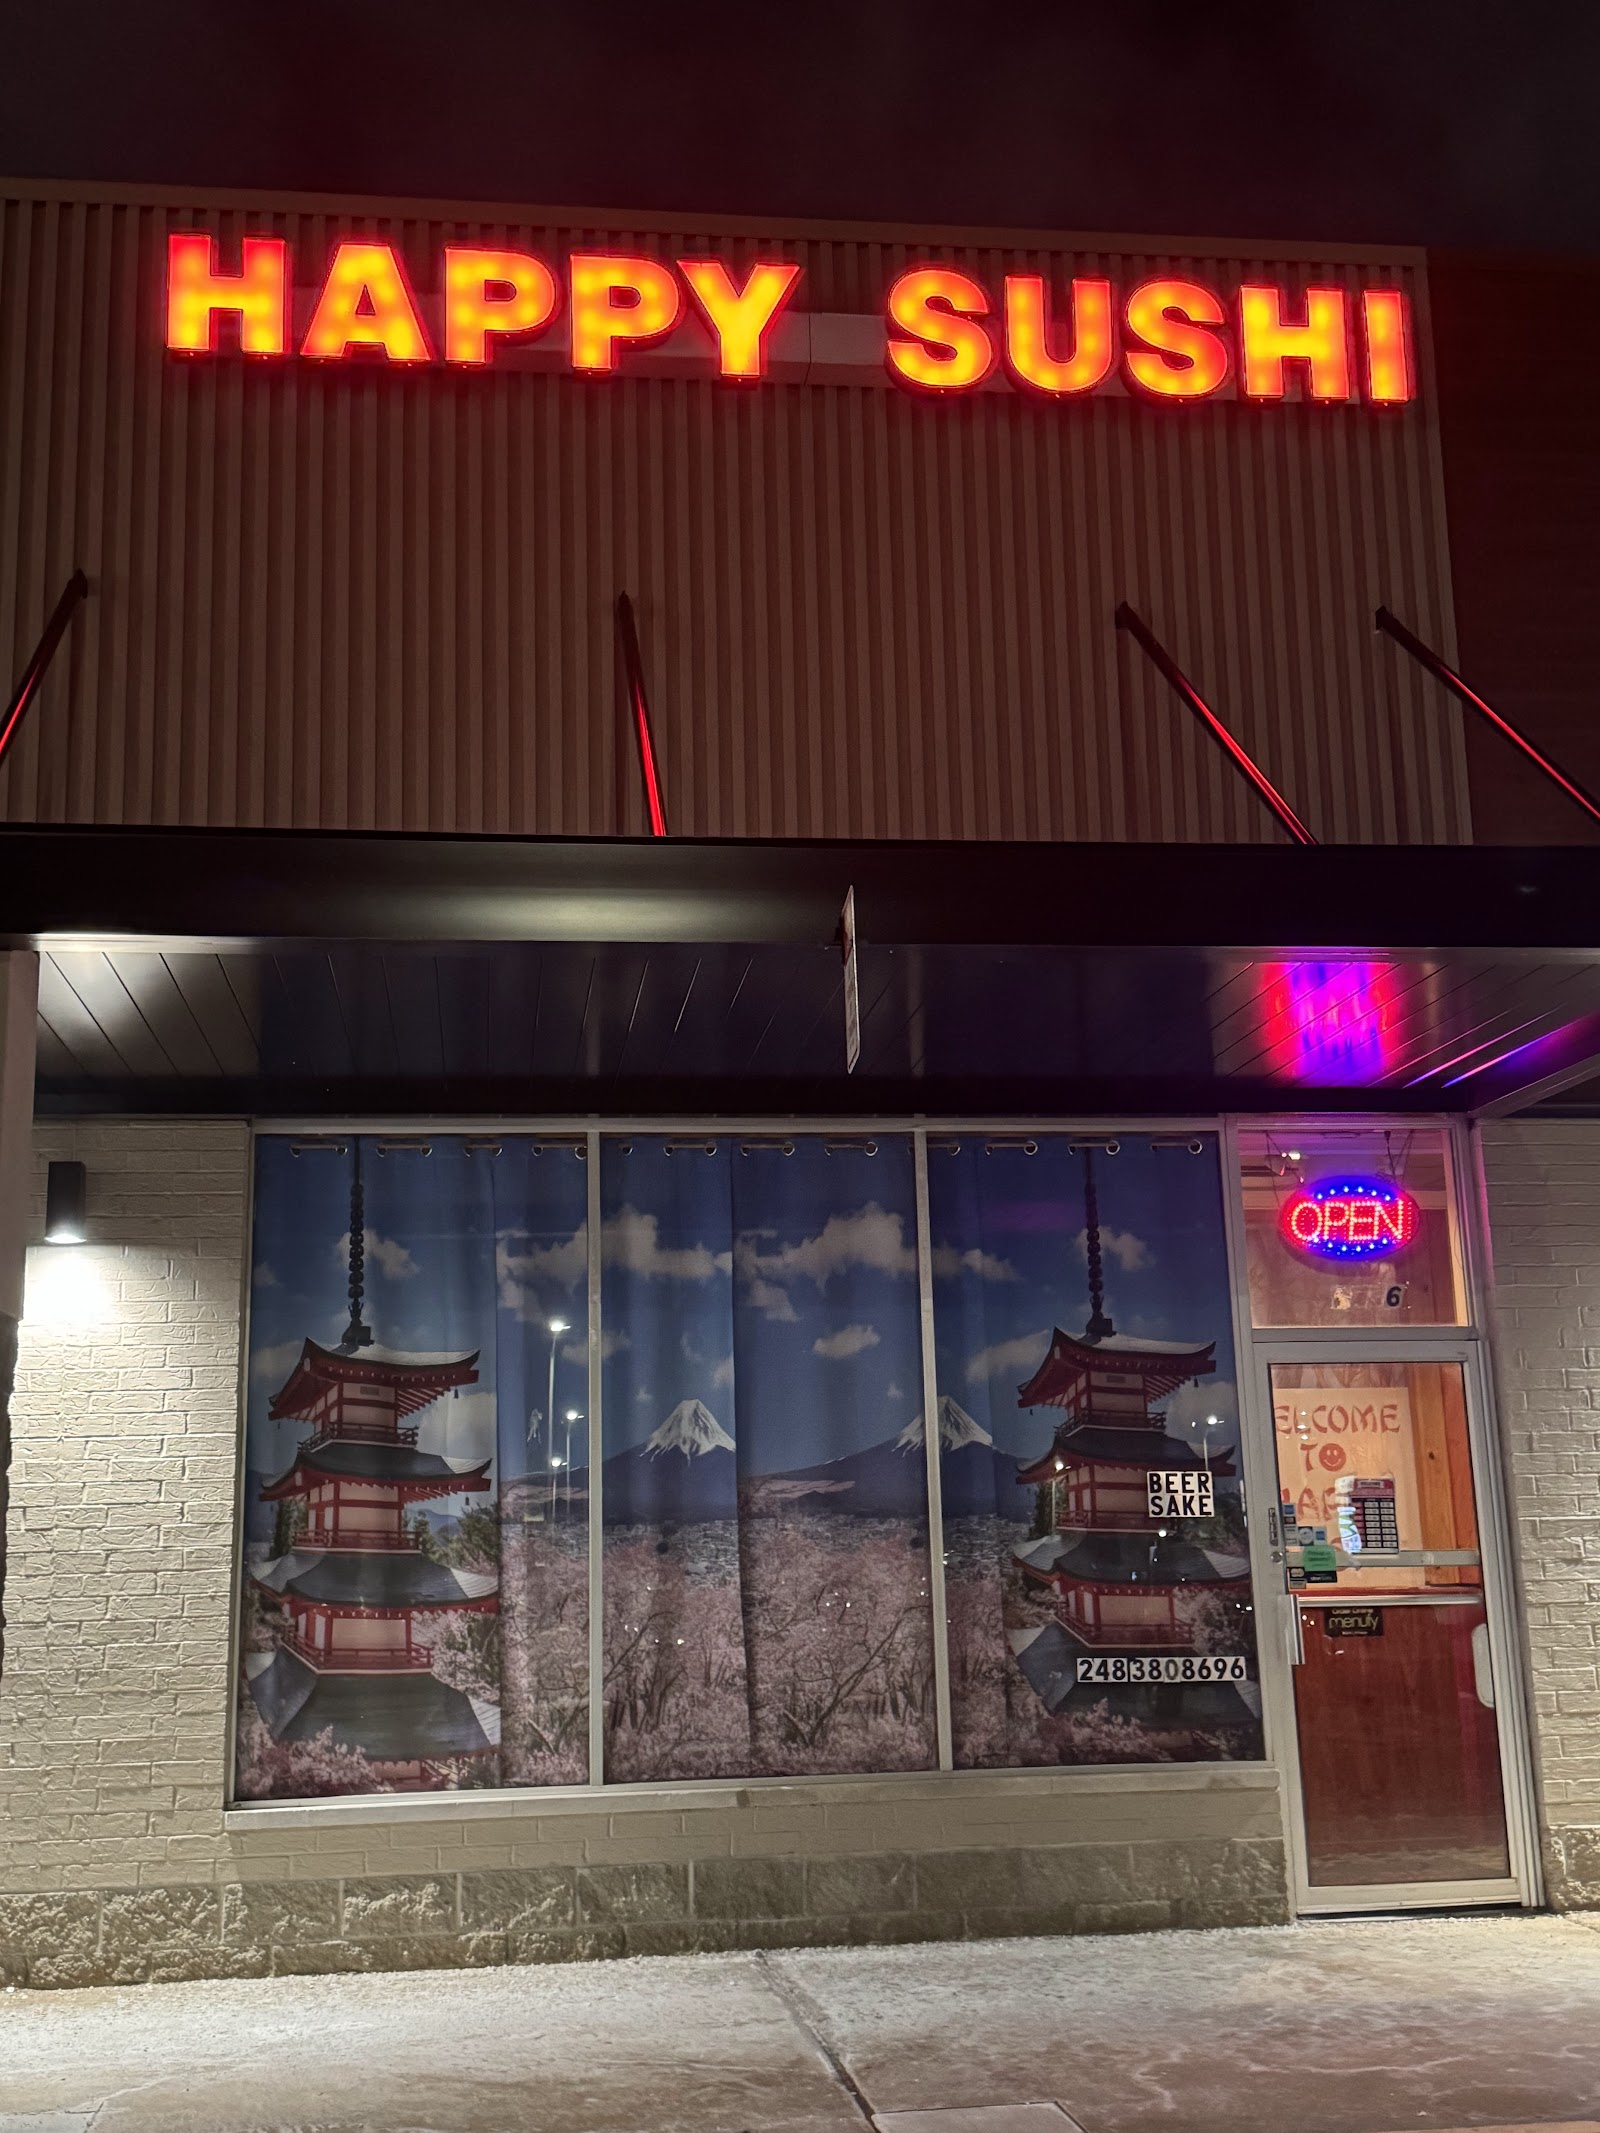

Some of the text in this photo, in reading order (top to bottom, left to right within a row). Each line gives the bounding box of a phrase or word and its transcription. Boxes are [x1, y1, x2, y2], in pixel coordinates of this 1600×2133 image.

[165, 233, 1410, 403] HAPPY SUSHI
[1291, 1200, 1403, 1241] OPEN
[1385, 1285, 1402, 1307] 6
[1275, 1404, 1400, 1434] ELCOME
[1149, 1472, 1211, 1494] BEER
[1150, 1495, 1213, 1516] SAKE
